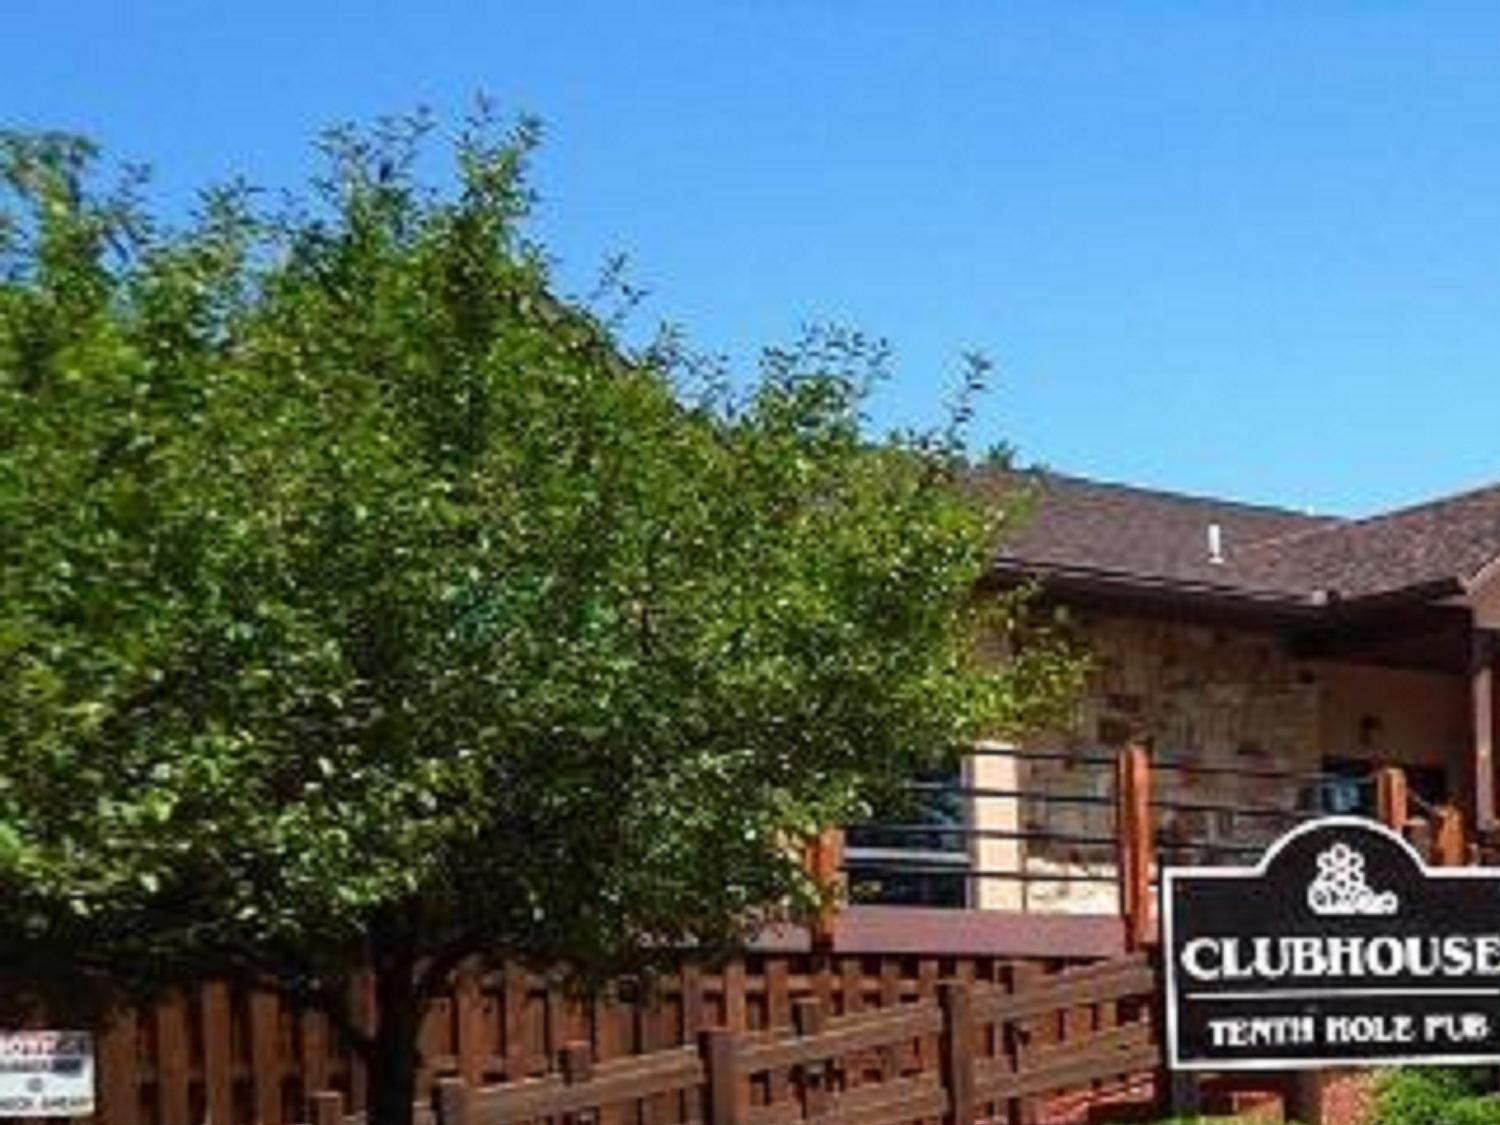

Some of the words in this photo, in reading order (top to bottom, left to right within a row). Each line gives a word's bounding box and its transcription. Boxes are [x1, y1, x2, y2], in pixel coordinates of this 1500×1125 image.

[1209, 1015, 1314, 1046] TENTH
[1326, 1014, 1416, 1043] HOLE
[1424, 1012, 1490, 1042] PUB
